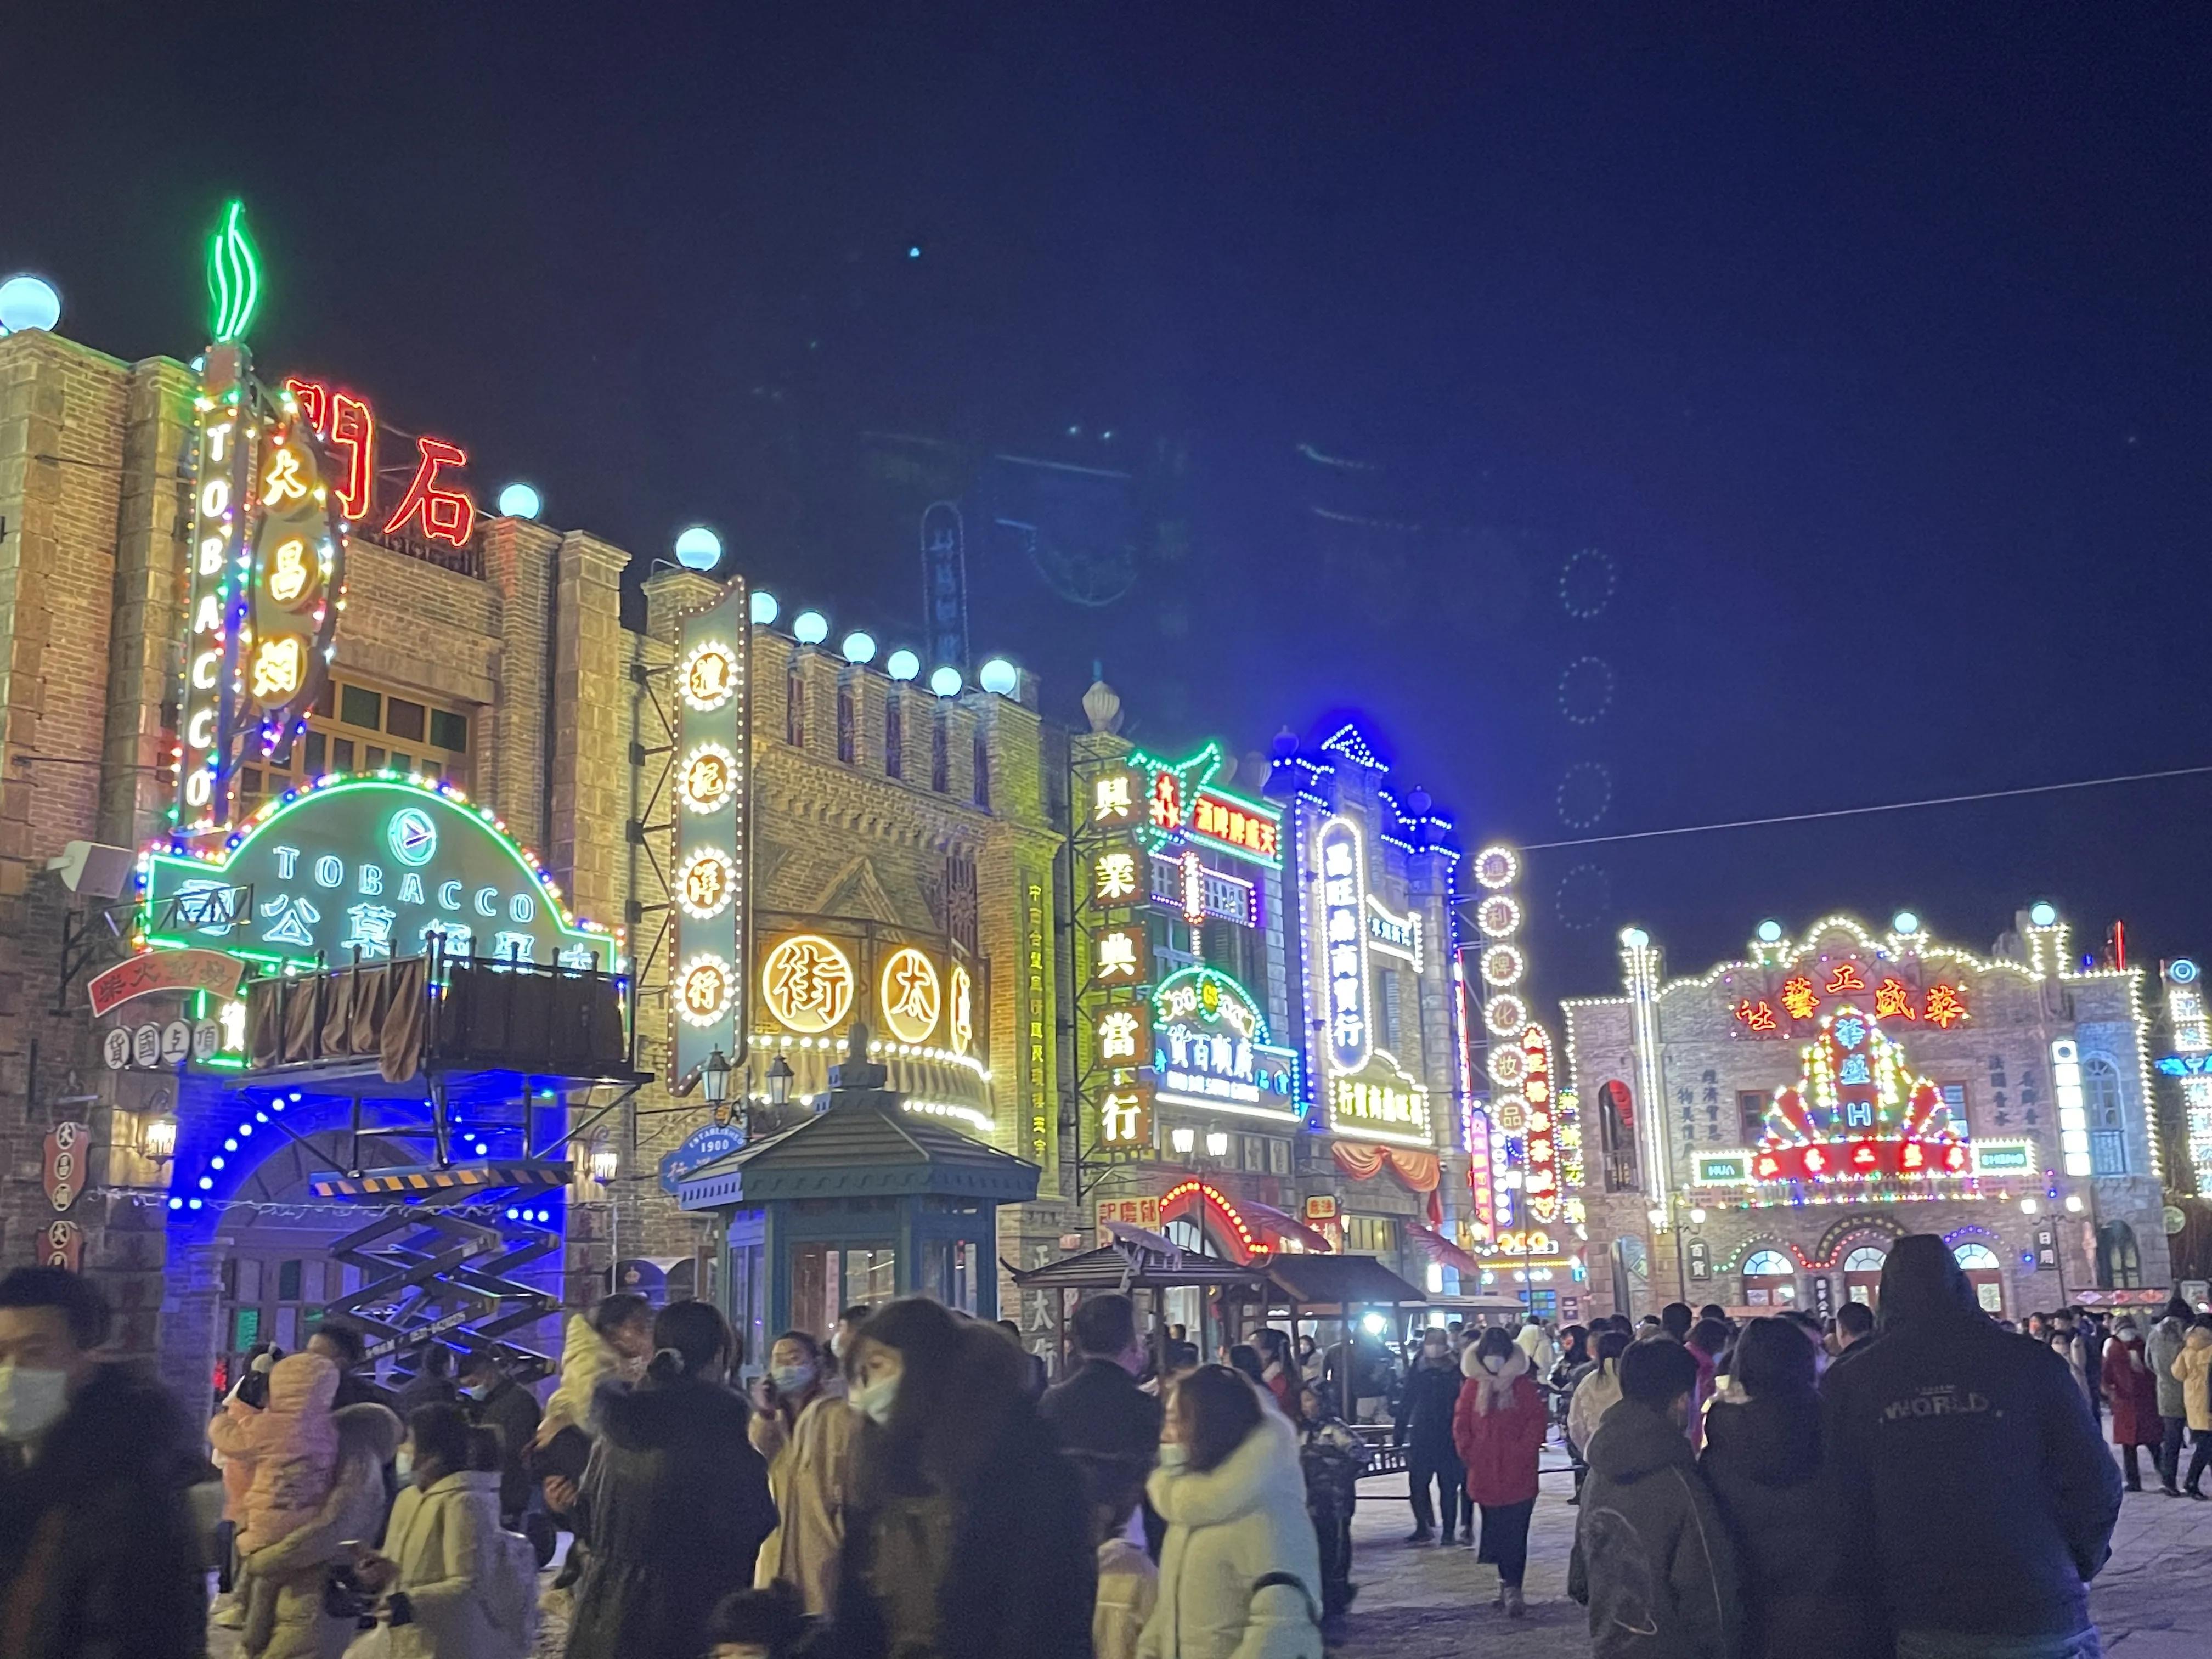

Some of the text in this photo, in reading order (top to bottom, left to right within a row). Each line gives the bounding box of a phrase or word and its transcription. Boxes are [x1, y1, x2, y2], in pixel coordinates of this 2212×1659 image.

[186, 424, 229, 807] TOBACCO
[273, 845, 534, 923] TOBACCO
[1094, 776, 1142, 1142] 興業典當行
[689, 1126, 744, 1148] ESTABLISHED
[1847, 1101, 1871, 1126] H
[701, 1139, 729, 1153] 1900
